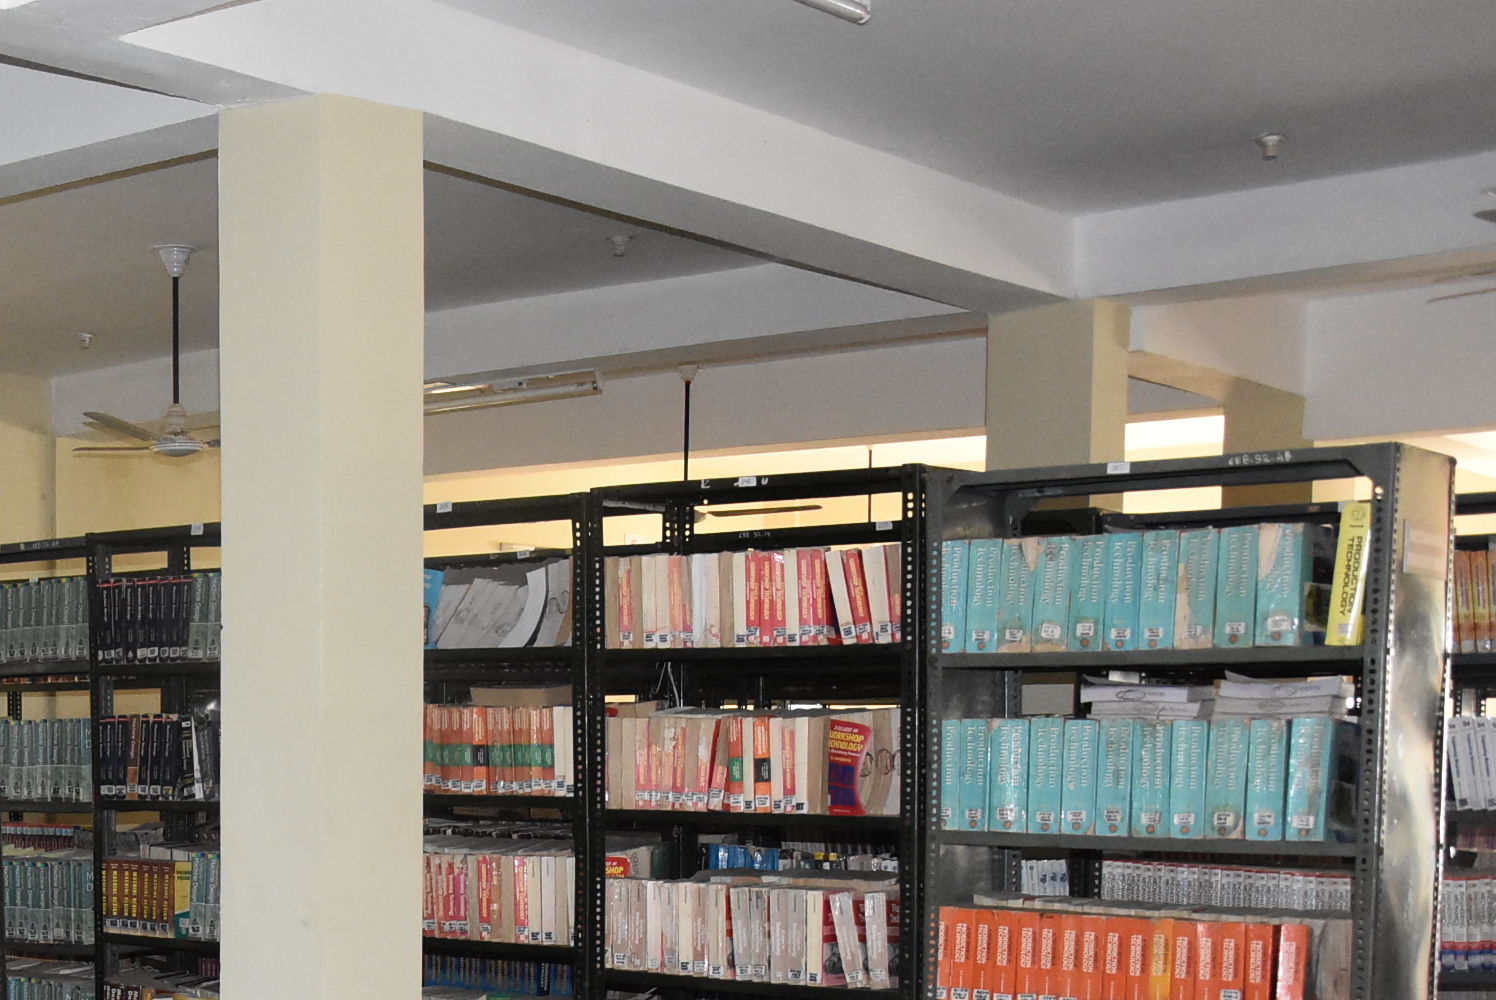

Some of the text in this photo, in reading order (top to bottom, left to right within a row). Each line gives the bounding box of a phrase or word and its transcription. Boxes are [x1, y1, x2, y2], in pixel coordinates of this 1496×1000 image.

[974, 548, 986, 606] Technology
[986, 547, 998, 606] Production
[1078, 541, 1092, 602] Technology
[1090, 541, 1104, 602] Production
[1110, 542, 1122, 602] Technology
[1125, 540, 1137, 603] Production
[1338, 538, 1355, 616] TECHNOLOGY
[1347, 536, 1362, 614] PRODUCTION
[946, 726, 954, 784] Production
[1048, 727, 1060, 788] Production
